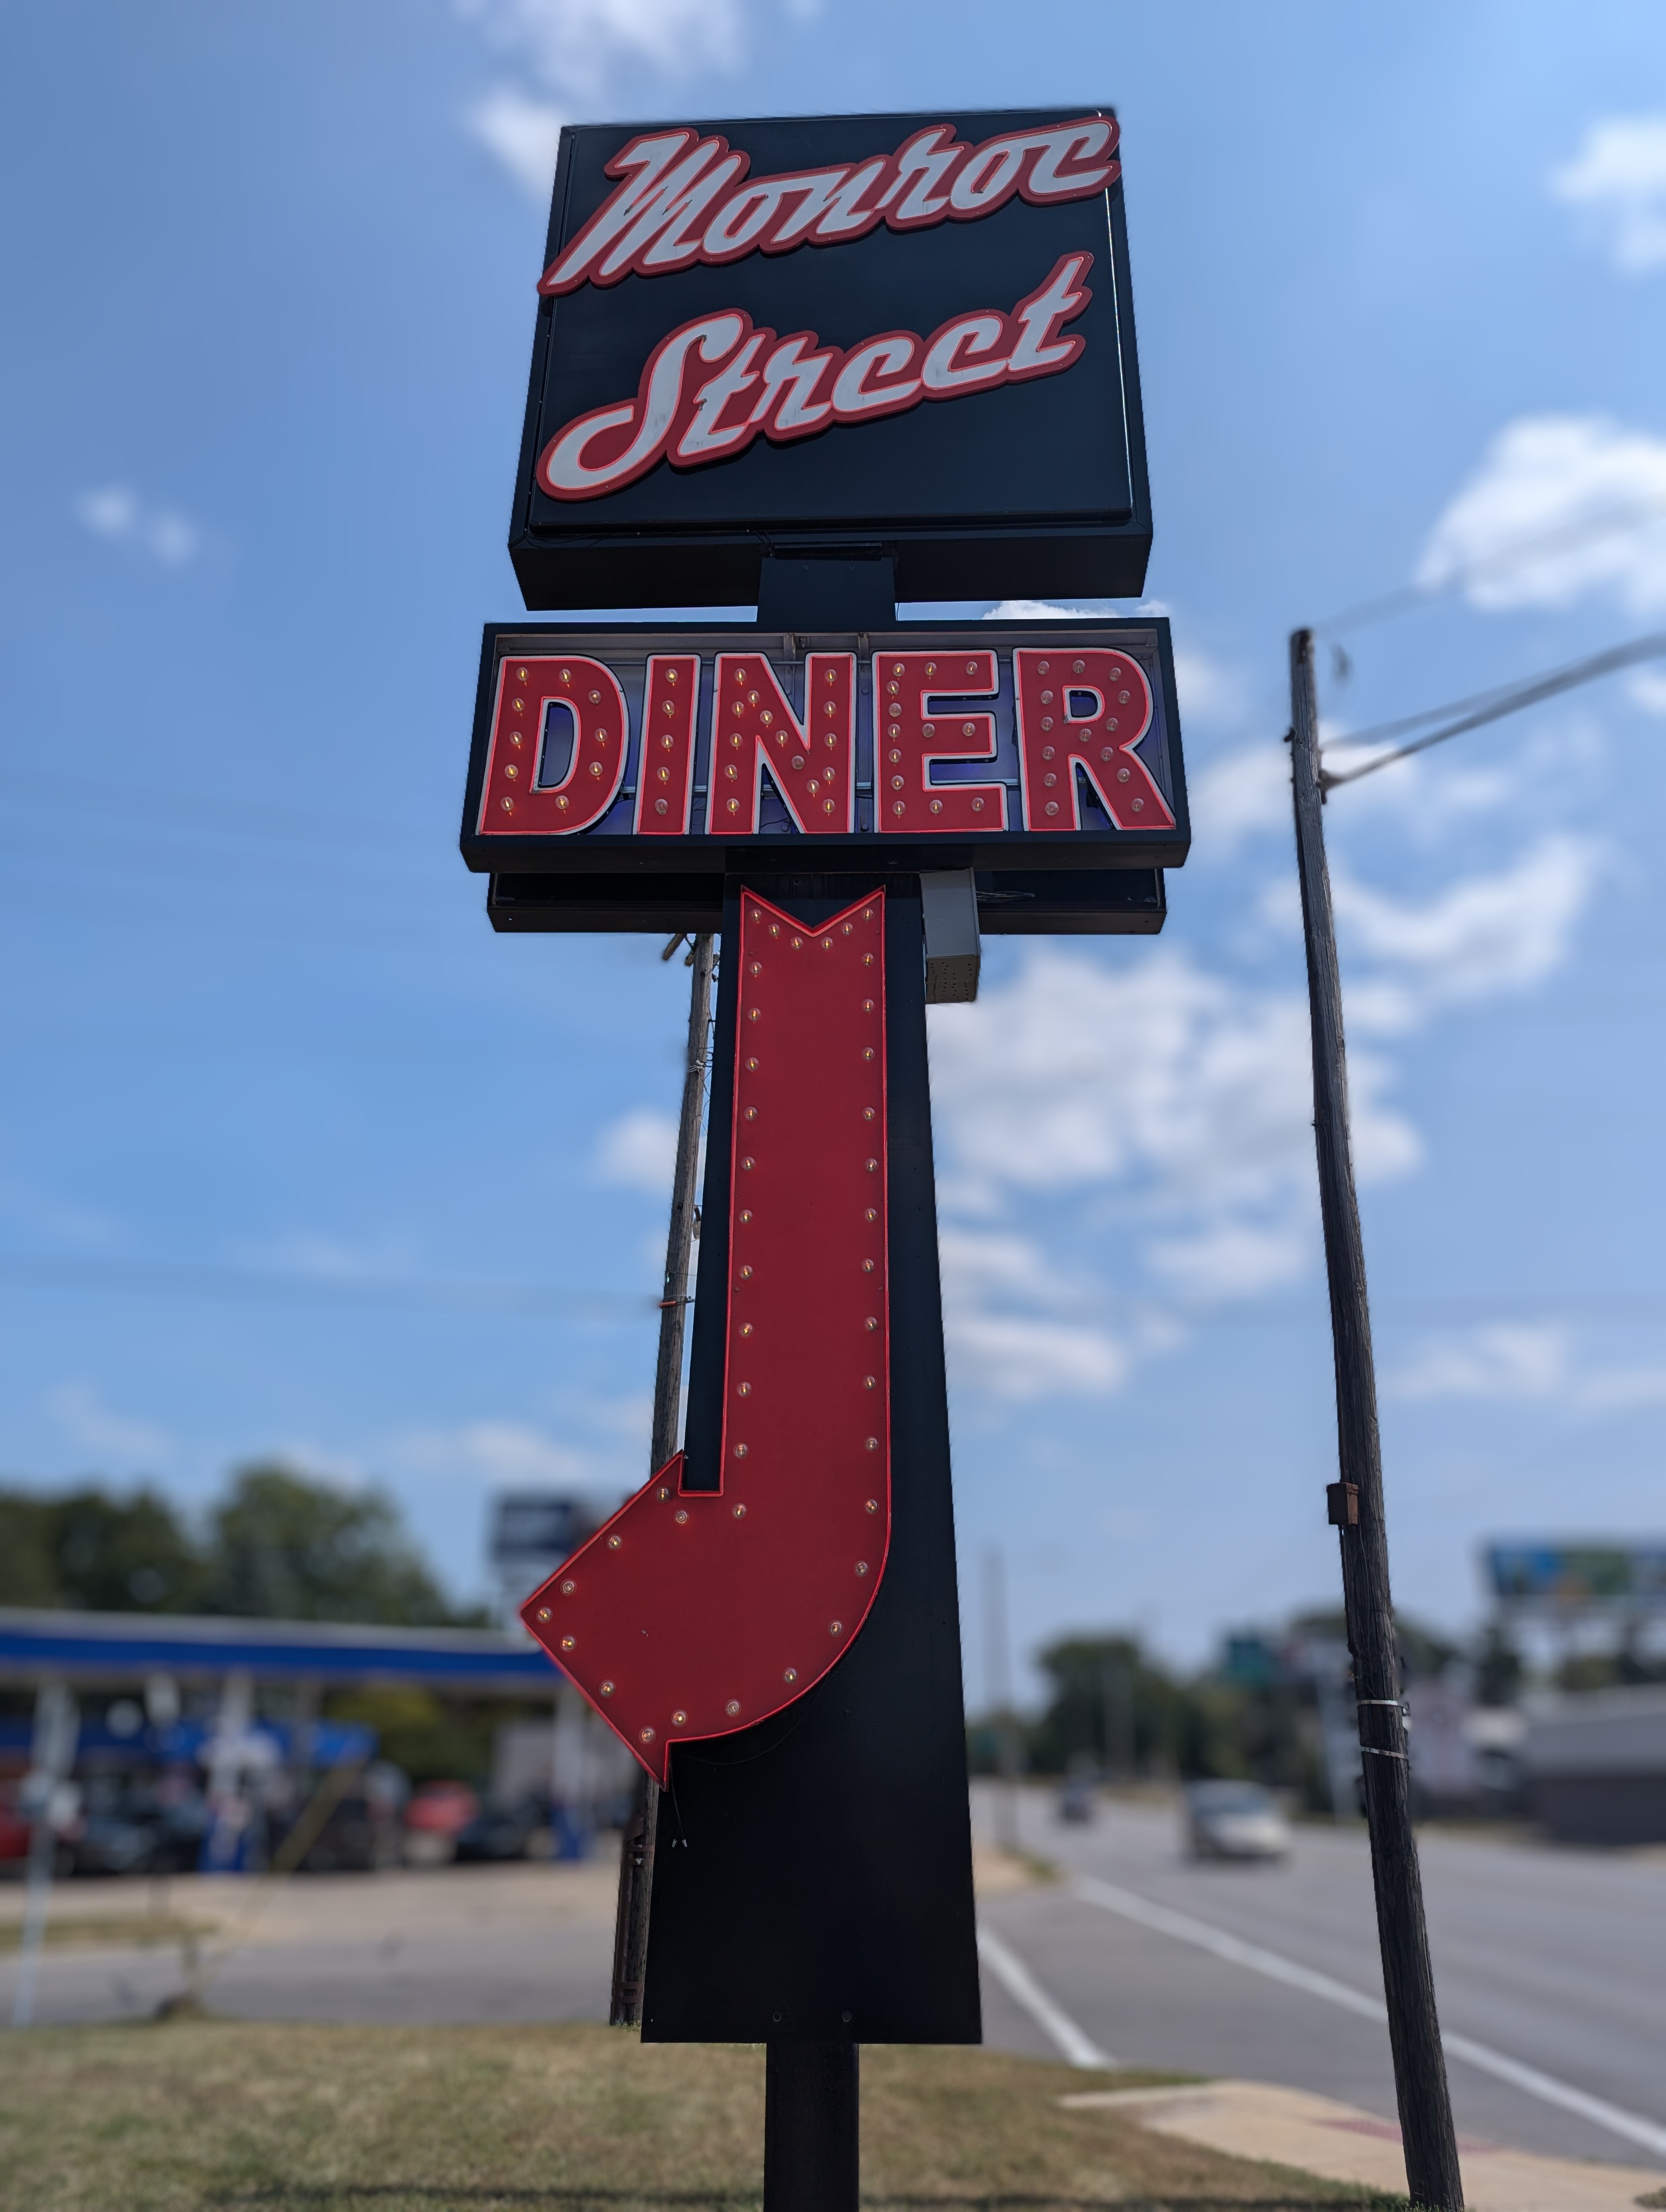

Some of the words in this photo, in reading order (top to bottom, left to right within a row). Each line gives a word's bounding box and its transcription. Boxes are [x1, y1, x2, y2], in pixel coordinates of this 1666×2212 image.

[540, 116, 1118, 294] Monroe
[539, 253, 1092, 499] Street
[476, 648, 1176, 835] DINER
